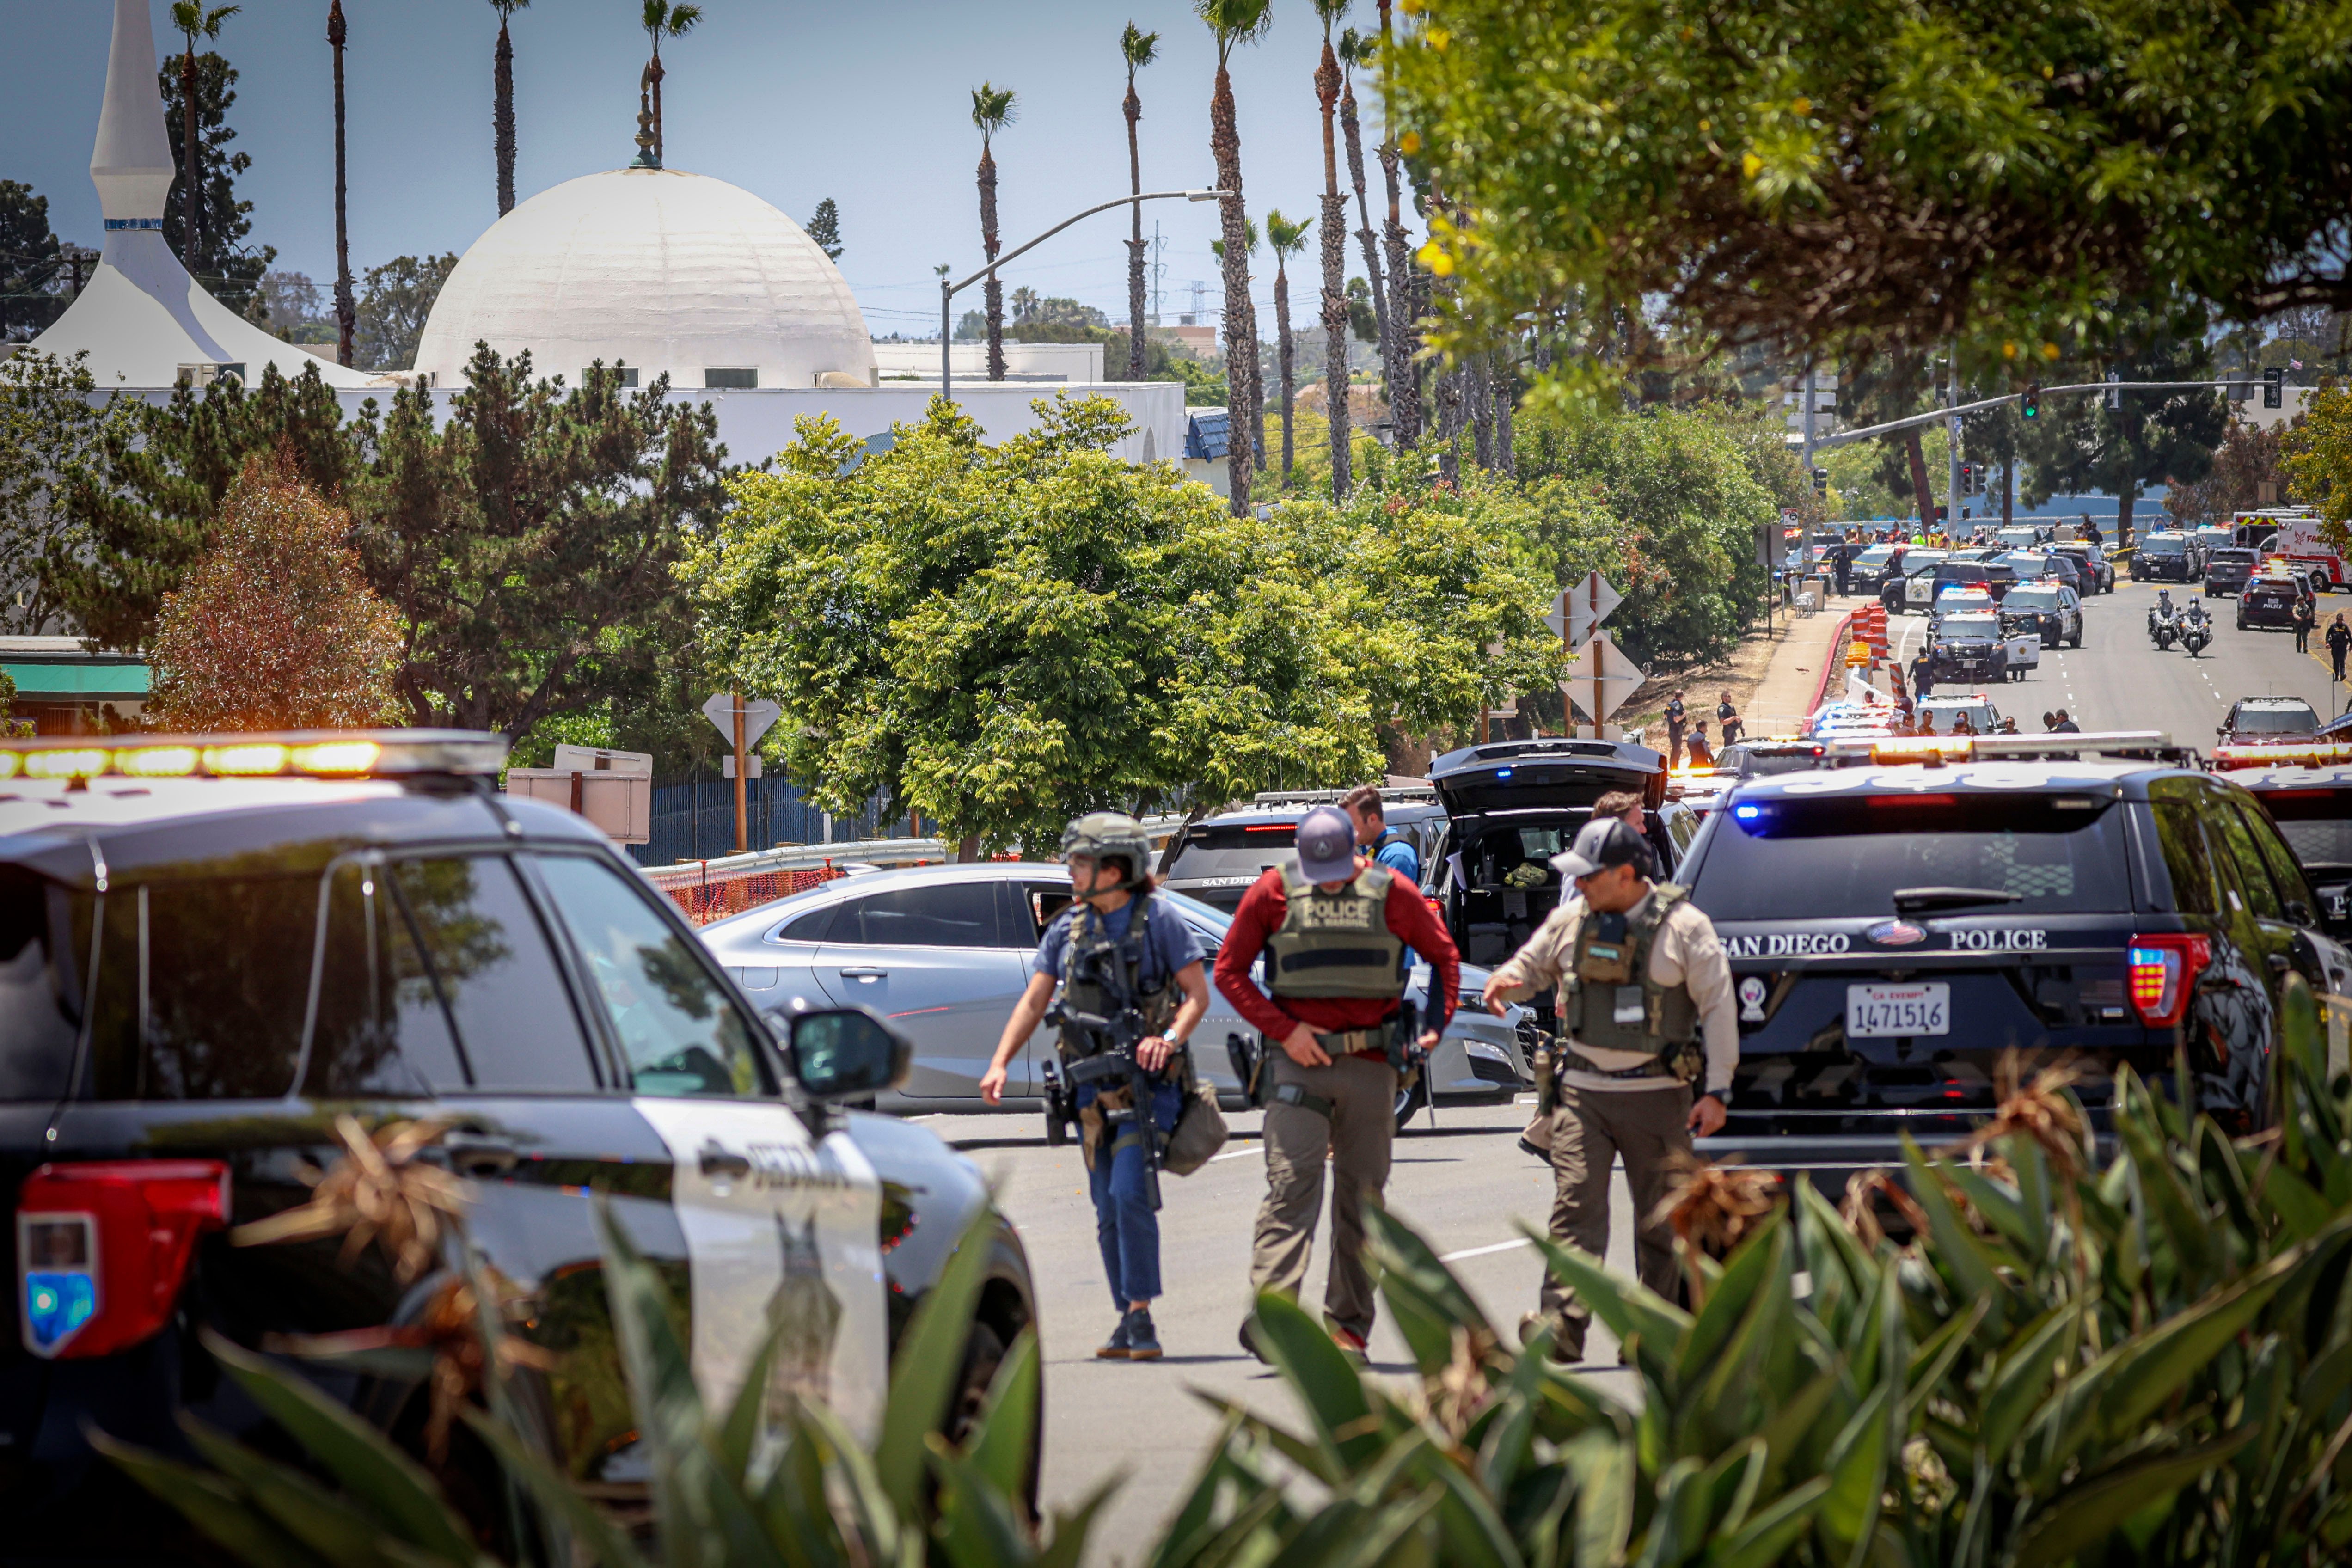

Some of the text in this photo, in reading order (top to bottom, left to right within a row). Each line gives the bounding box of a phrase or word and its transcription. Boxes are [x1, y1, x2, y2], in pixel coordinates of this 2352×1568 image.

[1304, 900, 1370, 919] POLICE
[1767, 932, 1850, 955] DIEGO
[1949, 929, 2047, 950] POLICE
[1856, 1002, 1942, 1029] 1471516
